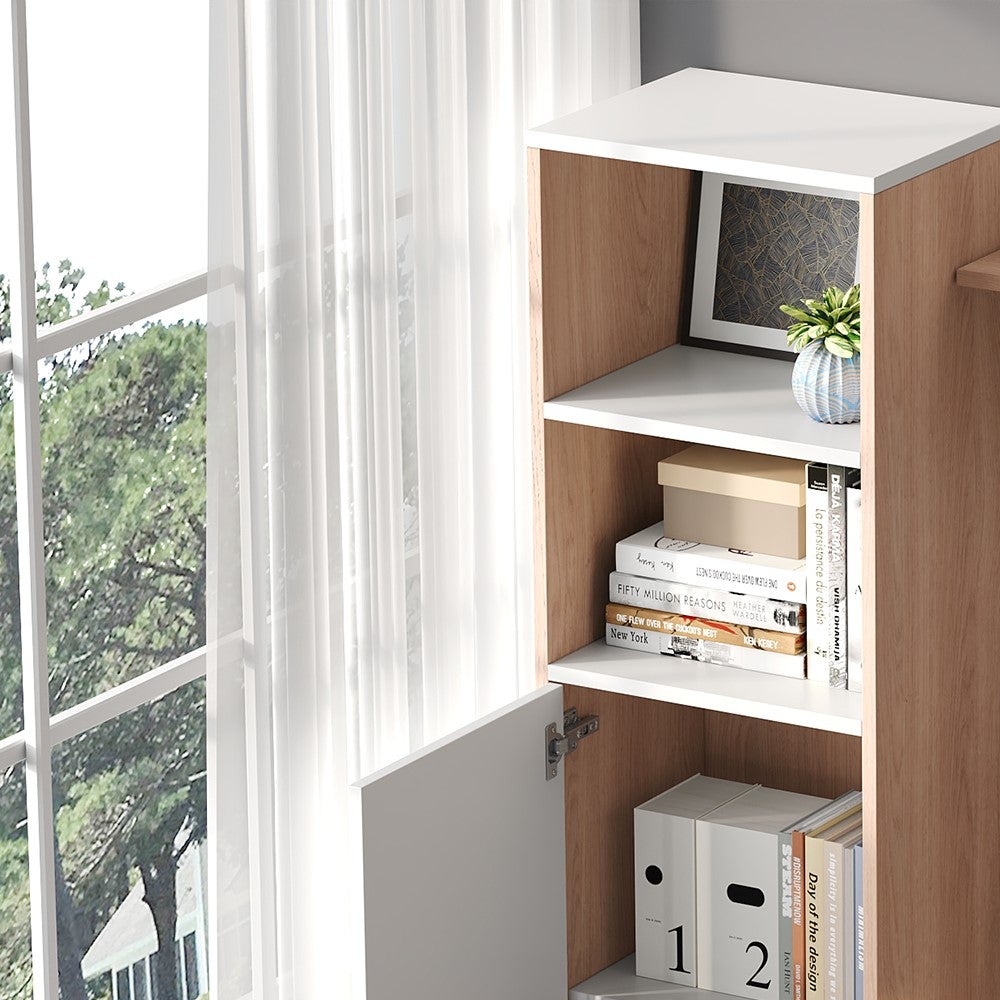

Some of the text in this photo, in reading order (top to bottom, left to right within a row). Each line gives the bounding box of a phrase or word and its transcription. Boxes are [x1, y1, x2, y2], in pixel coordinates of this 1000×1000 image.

[813, 522, 826, 578] persistance
[831, 513, 842, 562] KARMA
[617, 583, 726, 612] FIFTY MILLION REASONS
[816, 580, 827, 593] du
[732, 609, 767, 623] WARDELL
[733, 600, 766, 613] HEATHER
[816, 596, 828, 625] destin
[610, 628, 649, 644] New York
[616, 613, 627, 623] ONE
[628, 615, 646, 626] FLEW
[646, 619, 661, 629] OVER
[663, 621, 675, 631] THE
[702, 628, 718, 638] NEST
[743, 635, 779, 649] KEN KESEY
[781, 843, 792, 918] STEAM
[793, 856, 802, 926] #DISRUPTMENOW
[827, 853, 837, 901] simplicity
[829, 903, 837, 912] is
[829, 914, 837, 924] in
[807, 872, 819, 992] Day of the design
[668, 925, 691, 974] 1
[828, 927, 837, 978] everything
[745, 941, 772, 989] 2
[830, 980, 836, 993] we
